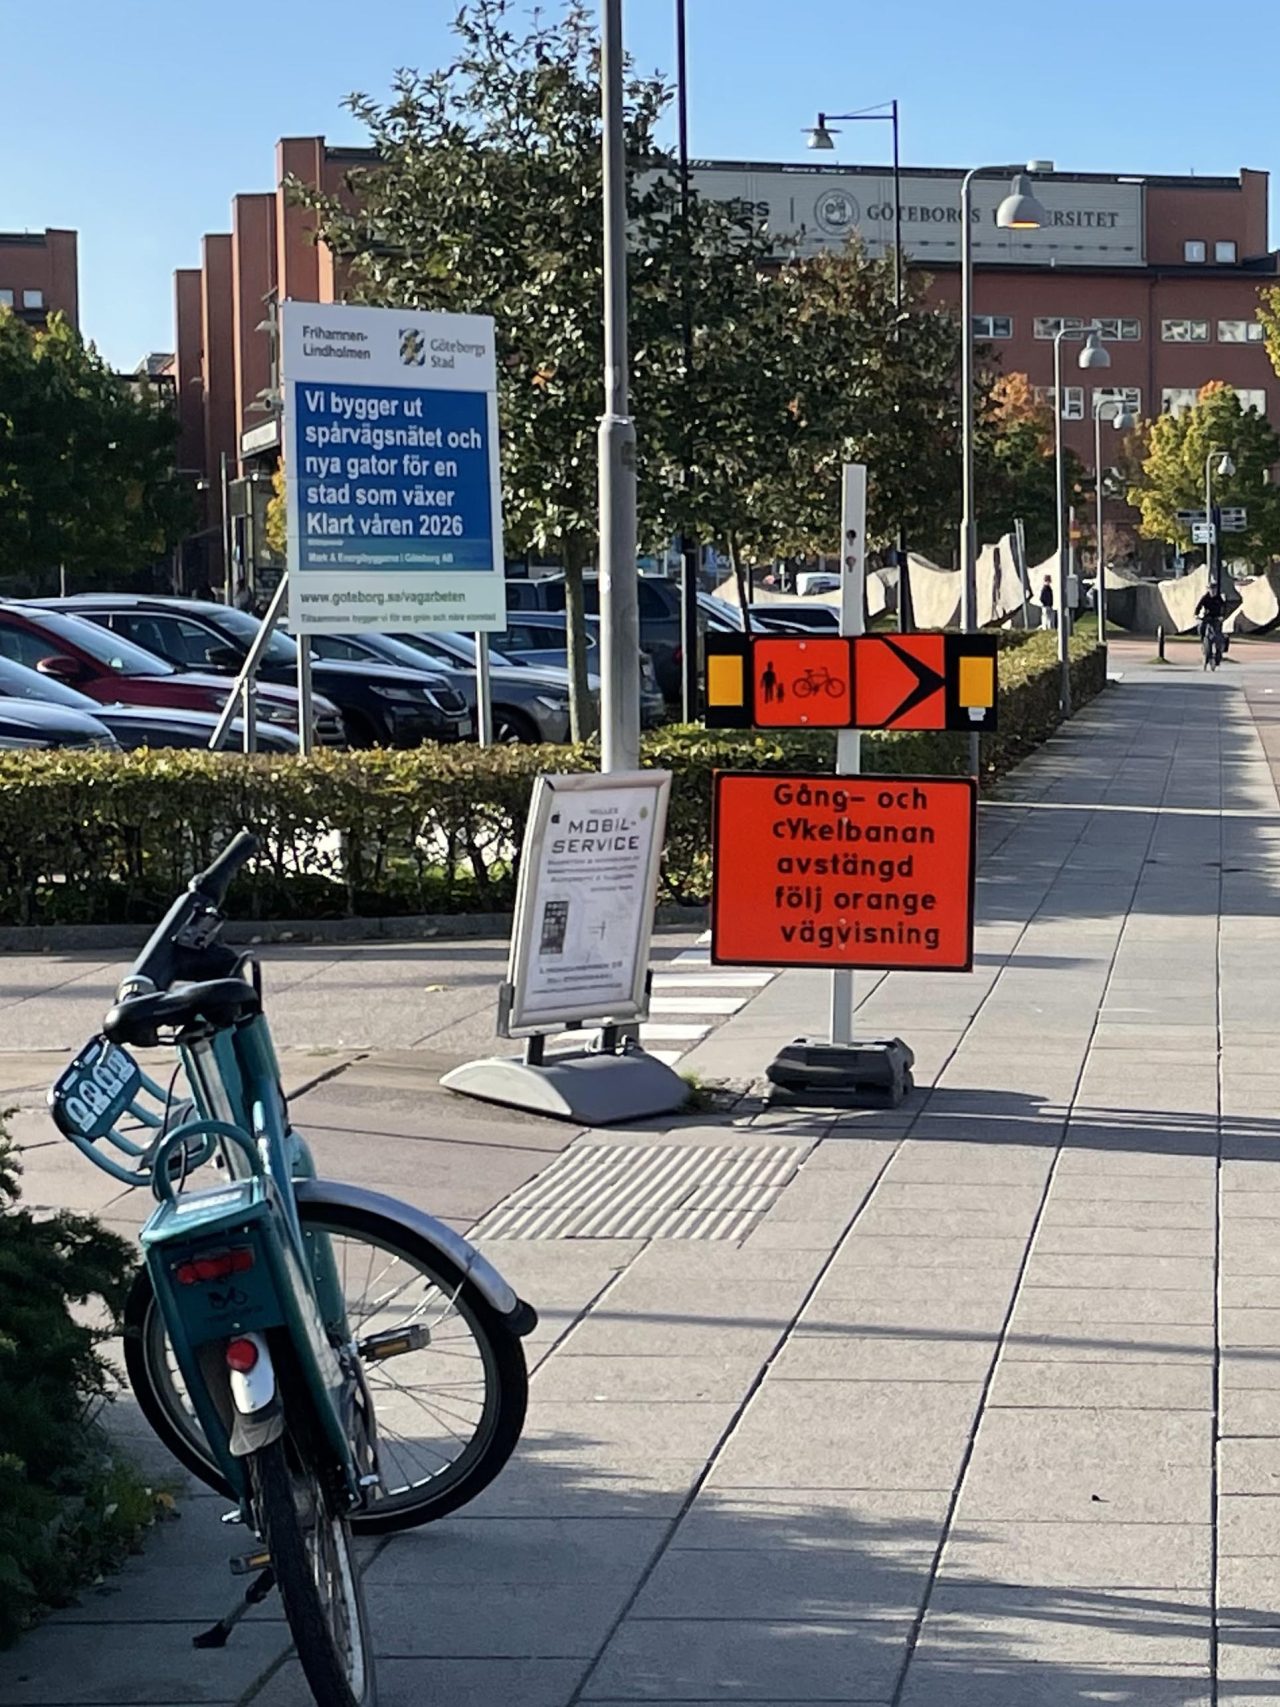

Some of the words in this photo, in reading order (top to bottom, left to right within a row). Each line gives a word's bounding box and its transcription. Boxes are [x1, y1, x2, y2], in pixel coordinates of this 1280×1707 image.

[866, 201, 981, 223] GÖTEBORS
[302, 325, 369, 342] Frihamnen-
[303, 344, 371, 360] Lindholmen
[430, 338, 486, 358] Göteborgs
[431, 356, 456, 369] Stad
[305, 390, 325, 413] Vi
[330, 391, 399, 421] bygger
[403, 397, 423, 418] ut
[305, 421, 443, 451] spårvägsnätet
[447, 428, 482, 449] och
[305, 456, 342, 478] nya
[346, 455, 399, 480] gator
[403, 454, 430, 477] för
[434, 460, 458, 478] en
[307, 483, 351, 505] stad
[355, 487, 397, 506] som
[402, 484, 456, 507] växer
[307, 512, 355, 536] Klart
[360, 513, 414, 536] våren
[419, 515, 464, 537] 2026
[774, 783, 865, 812] Gång-
[877, 787, 928, 810] och
[568, 817, 637, 835] MOBIL-
[772, 817, 935, 844] cykelbanan
[551, 835, 641, 854] SERVICE
[777, 852, 914, 883] avstängd
[775, 885, 823, 914] följ
[833, 891, 937, 916] orange
[780, 919, 940, 950] vägvisning
